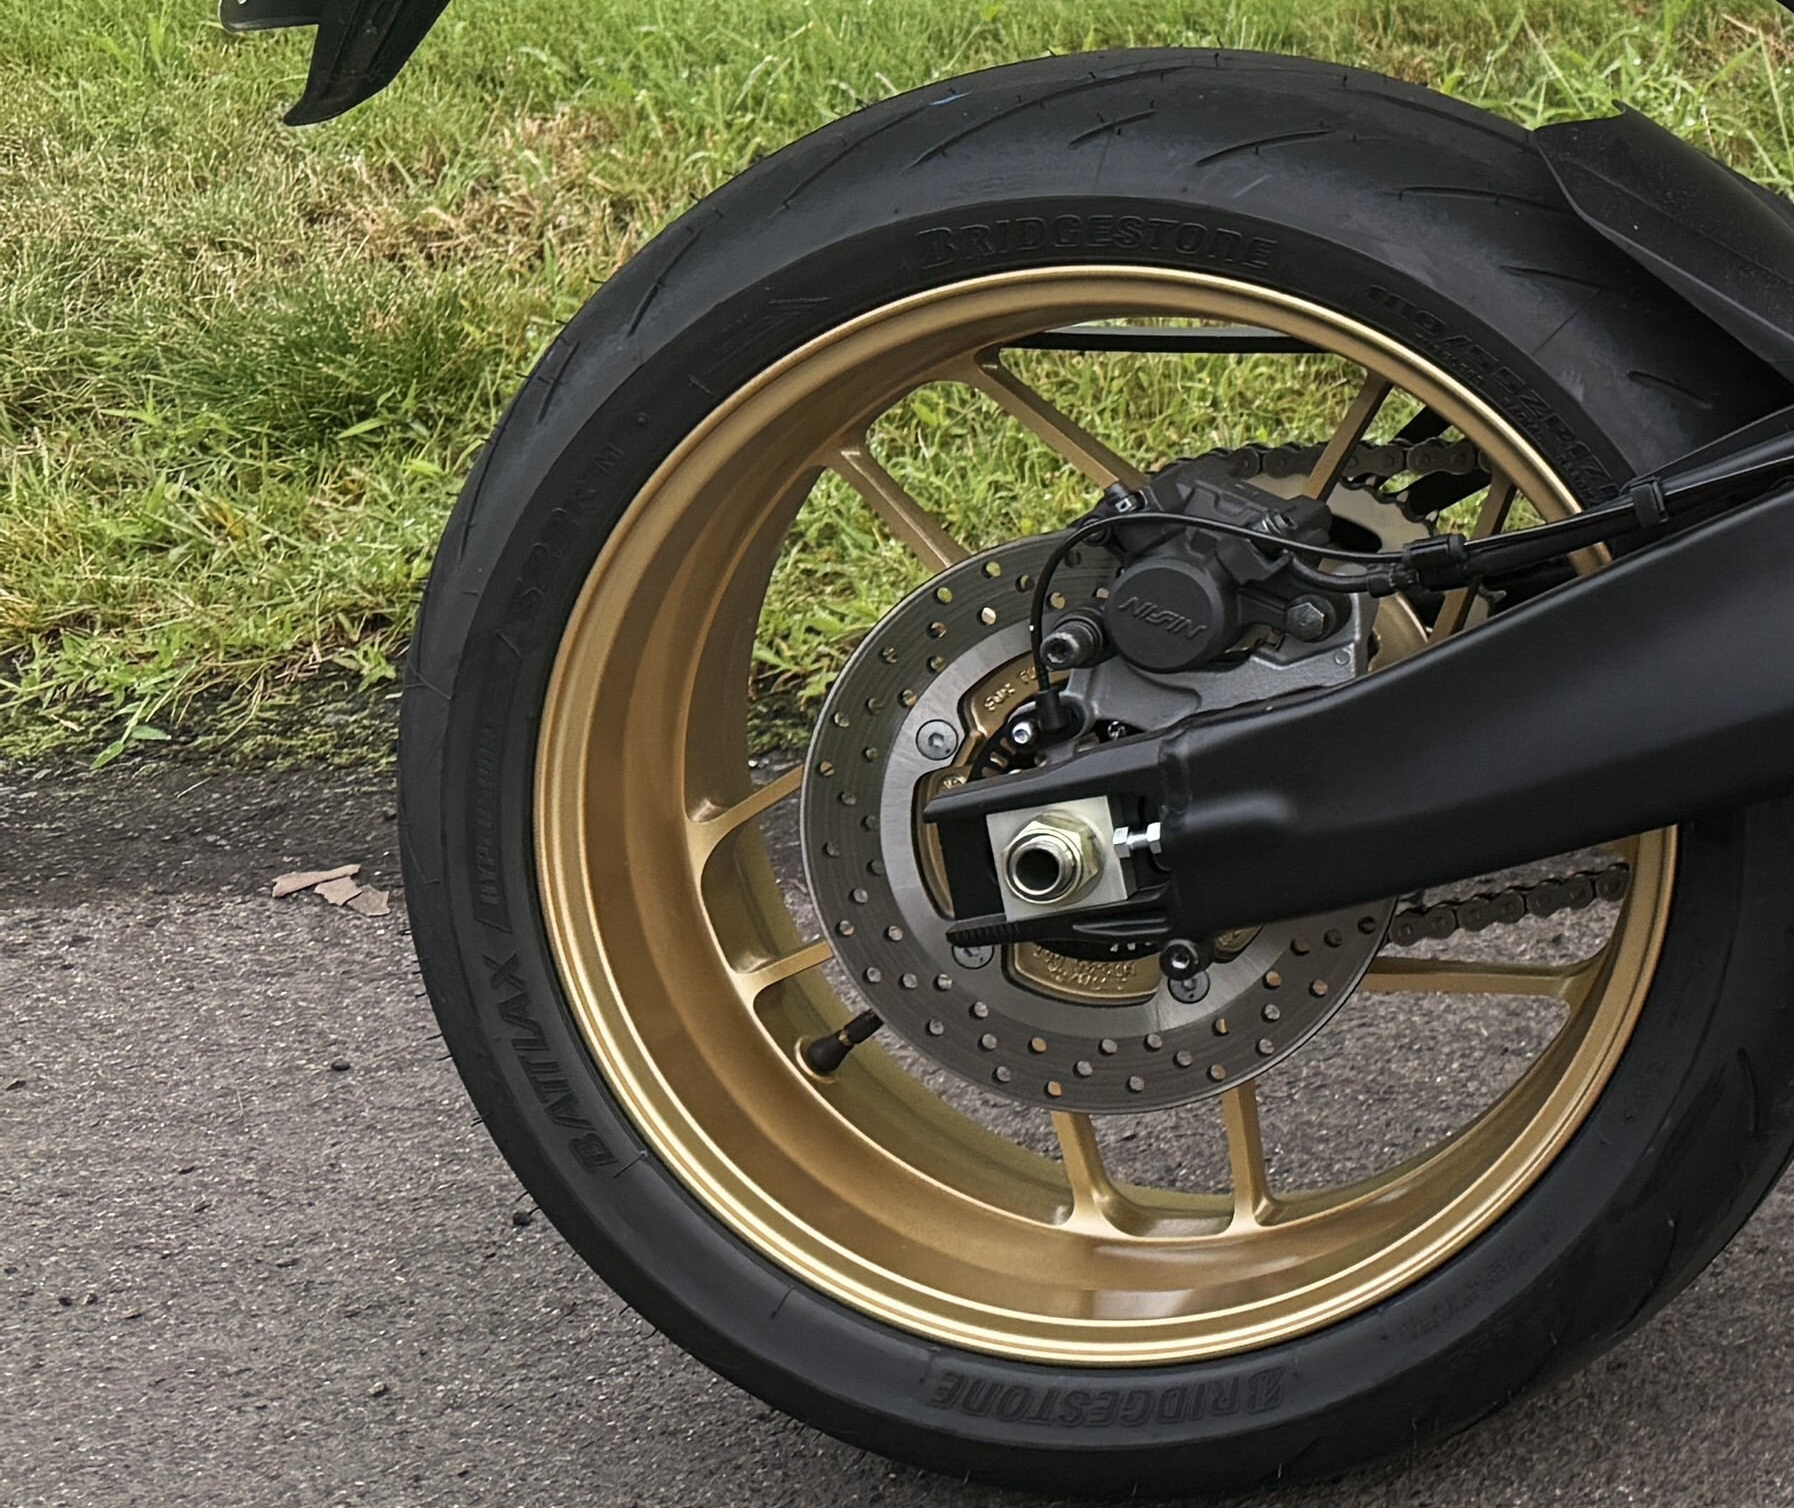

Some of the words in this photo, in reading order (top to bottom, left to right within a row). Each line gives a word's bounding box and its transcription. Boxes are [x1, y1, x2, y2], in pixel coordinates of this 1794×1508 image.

[915, 213, 1281, 272] BRIDGESTONE
[481, 944, 619, 1181] BATTLAX
[926, 1361, 1297, 1433] BRIDGESTONE
